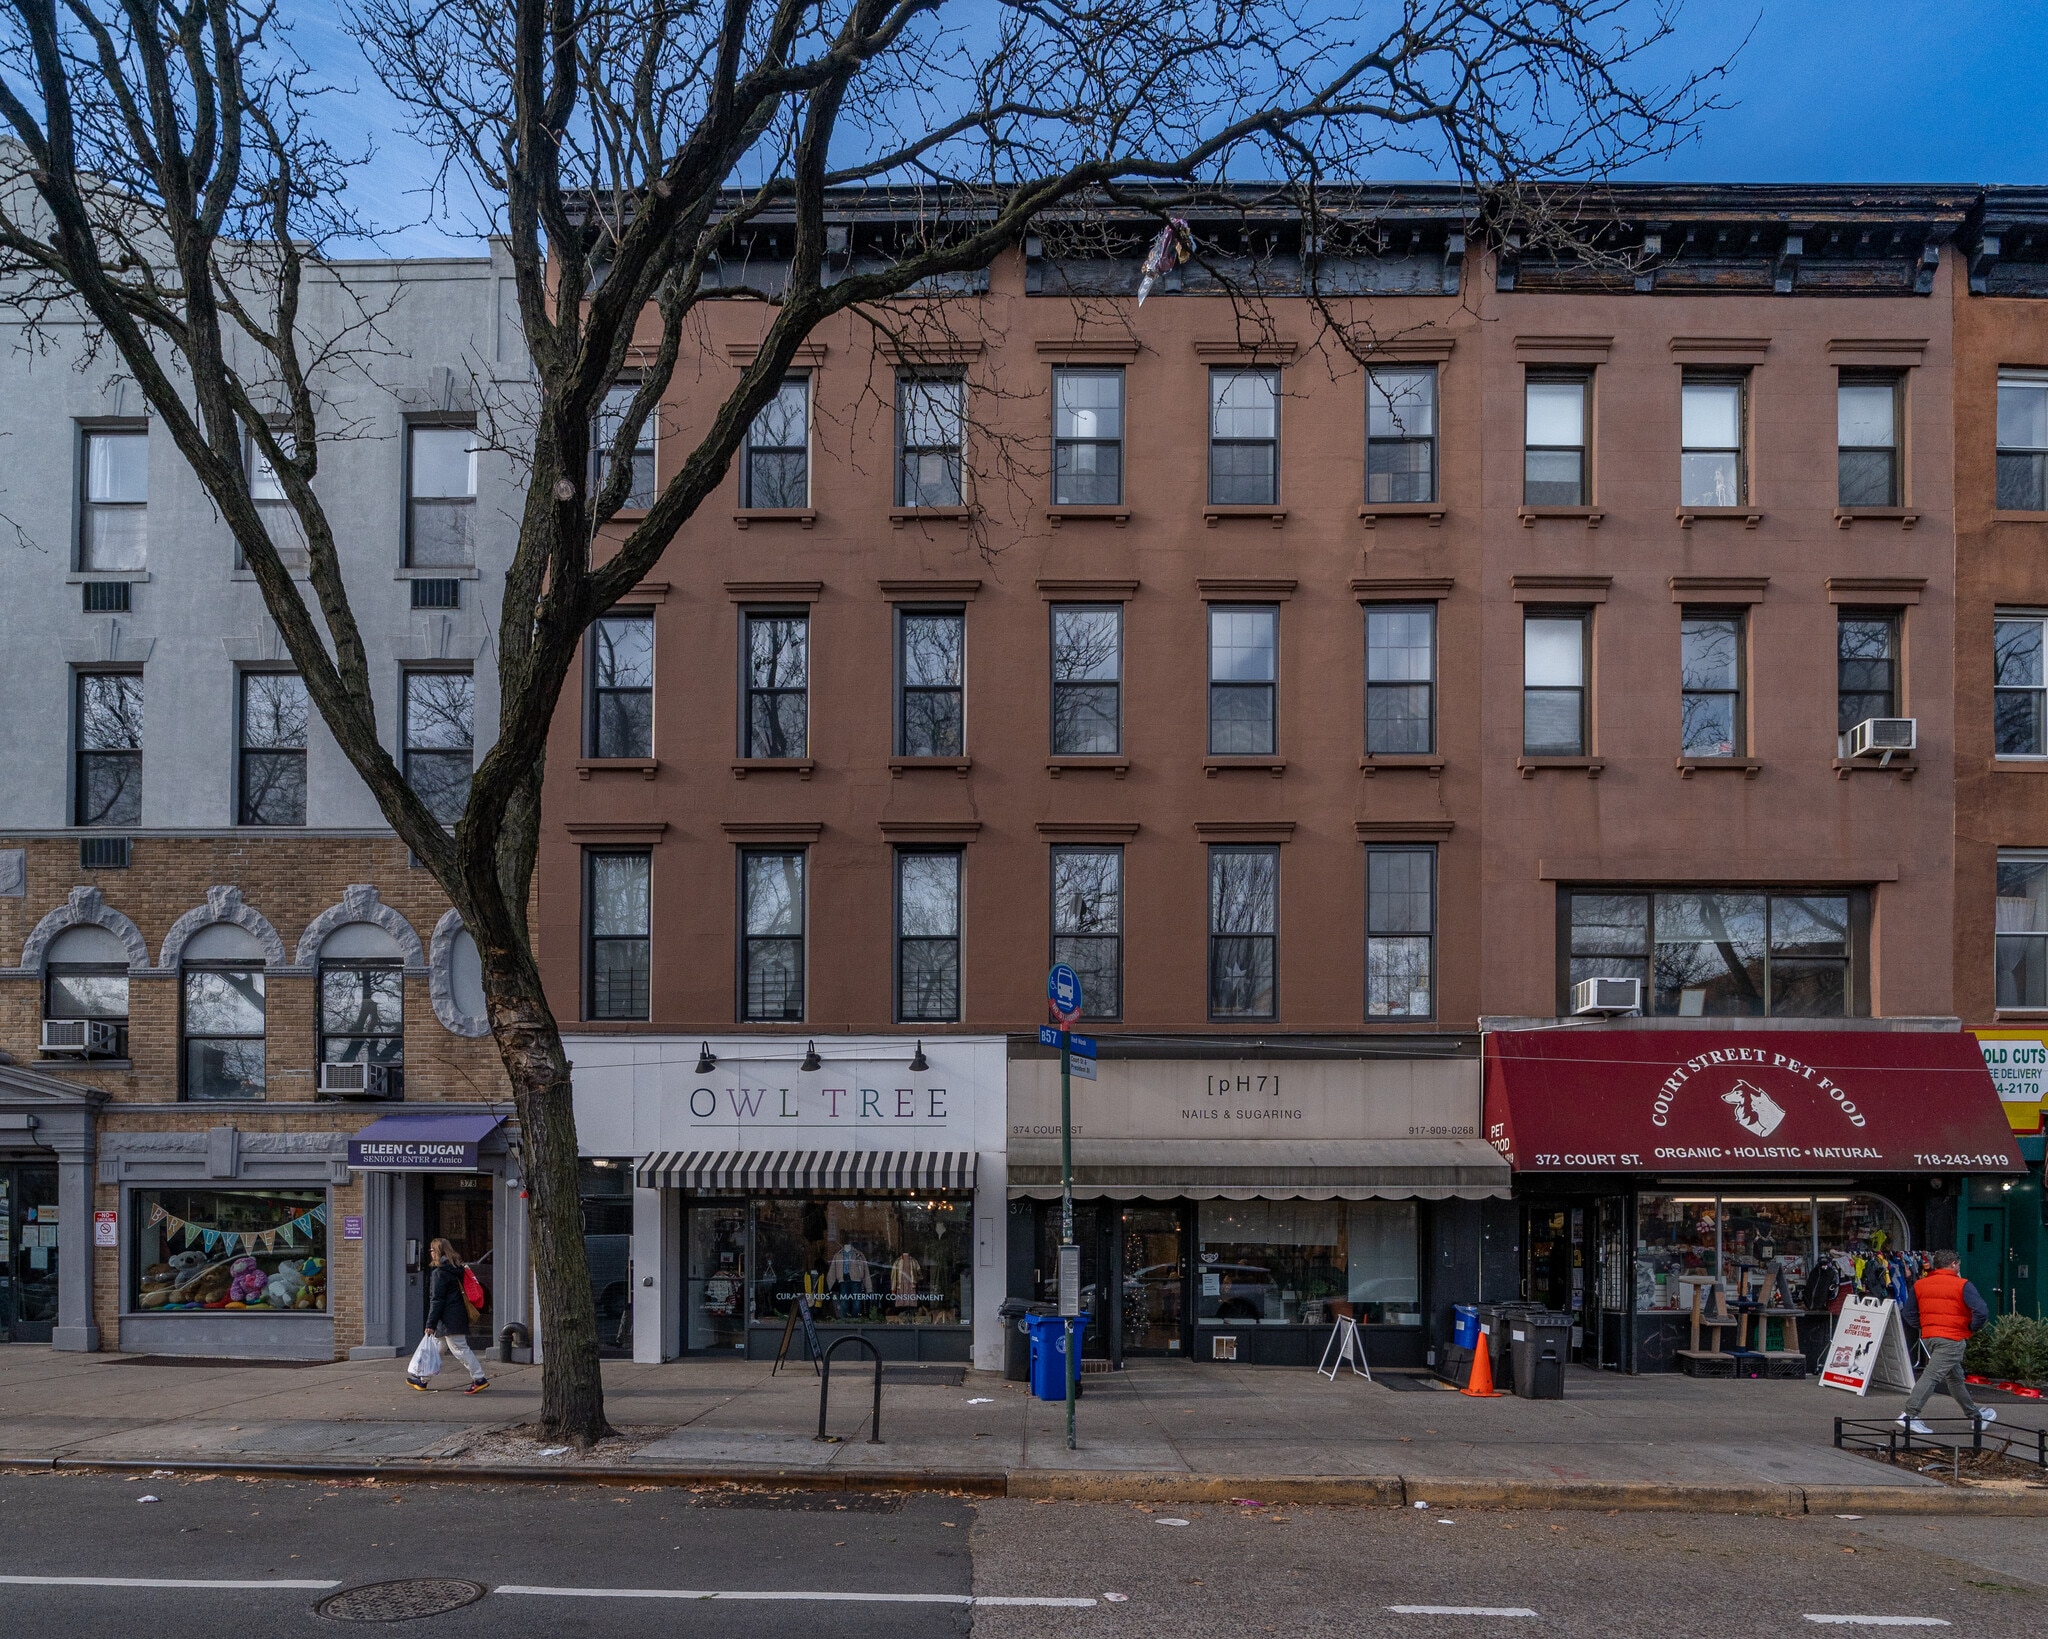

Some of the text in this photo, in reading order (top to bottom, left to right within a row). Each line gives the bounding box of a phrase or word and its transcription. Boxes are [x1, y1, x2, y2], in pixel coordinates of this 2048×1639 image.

[1041, 1029, 1057, 1044] B57
[1983, 1048, 2046, 1064] OLD CUTS
[2001, 1068, 2043, 1079] DELIVERY
[1652, 1047, 1866, 1128] COURT STREET PET FOOD
[1994, 1082, 2039, 1094] 4-2170
[690, 1087, 947, 1118] OWL TREE
[1182, 1109, 1302, 1120] NAILS & SUGARING
[1012, 1126, 1083, 1135] 374 COUR ST
[1408, 1126, 1474, 1135] 917-909-0268
[1490, 1122, 1504, 1139] PET
[360, 1143, 464, 1156] EILEEN C. DUGAN
[1654, 1147, 1883, 1159] ORGANIC HOLISTIC NATURAL
[363, 1155, 395, 1163] SENIOR
[396, 1155, 430, 1163] CENTER
[438, 1156, 463, 1164] Amico
[1535, 1154, 1643, 1165] 372 COURT ST.
[1913, 1154, 2009, 1166] 718-243-1919
[1010, 1203, 1033, 1215] 374
[776, 1292, 811, 1300] CURAD
[839, 1293, 884, 1301] MATERNITY
[885, 1293, 944, 1301] CONSIGNMENT
[1844, 1328, 1872, 1338] KITTEN STRONG
